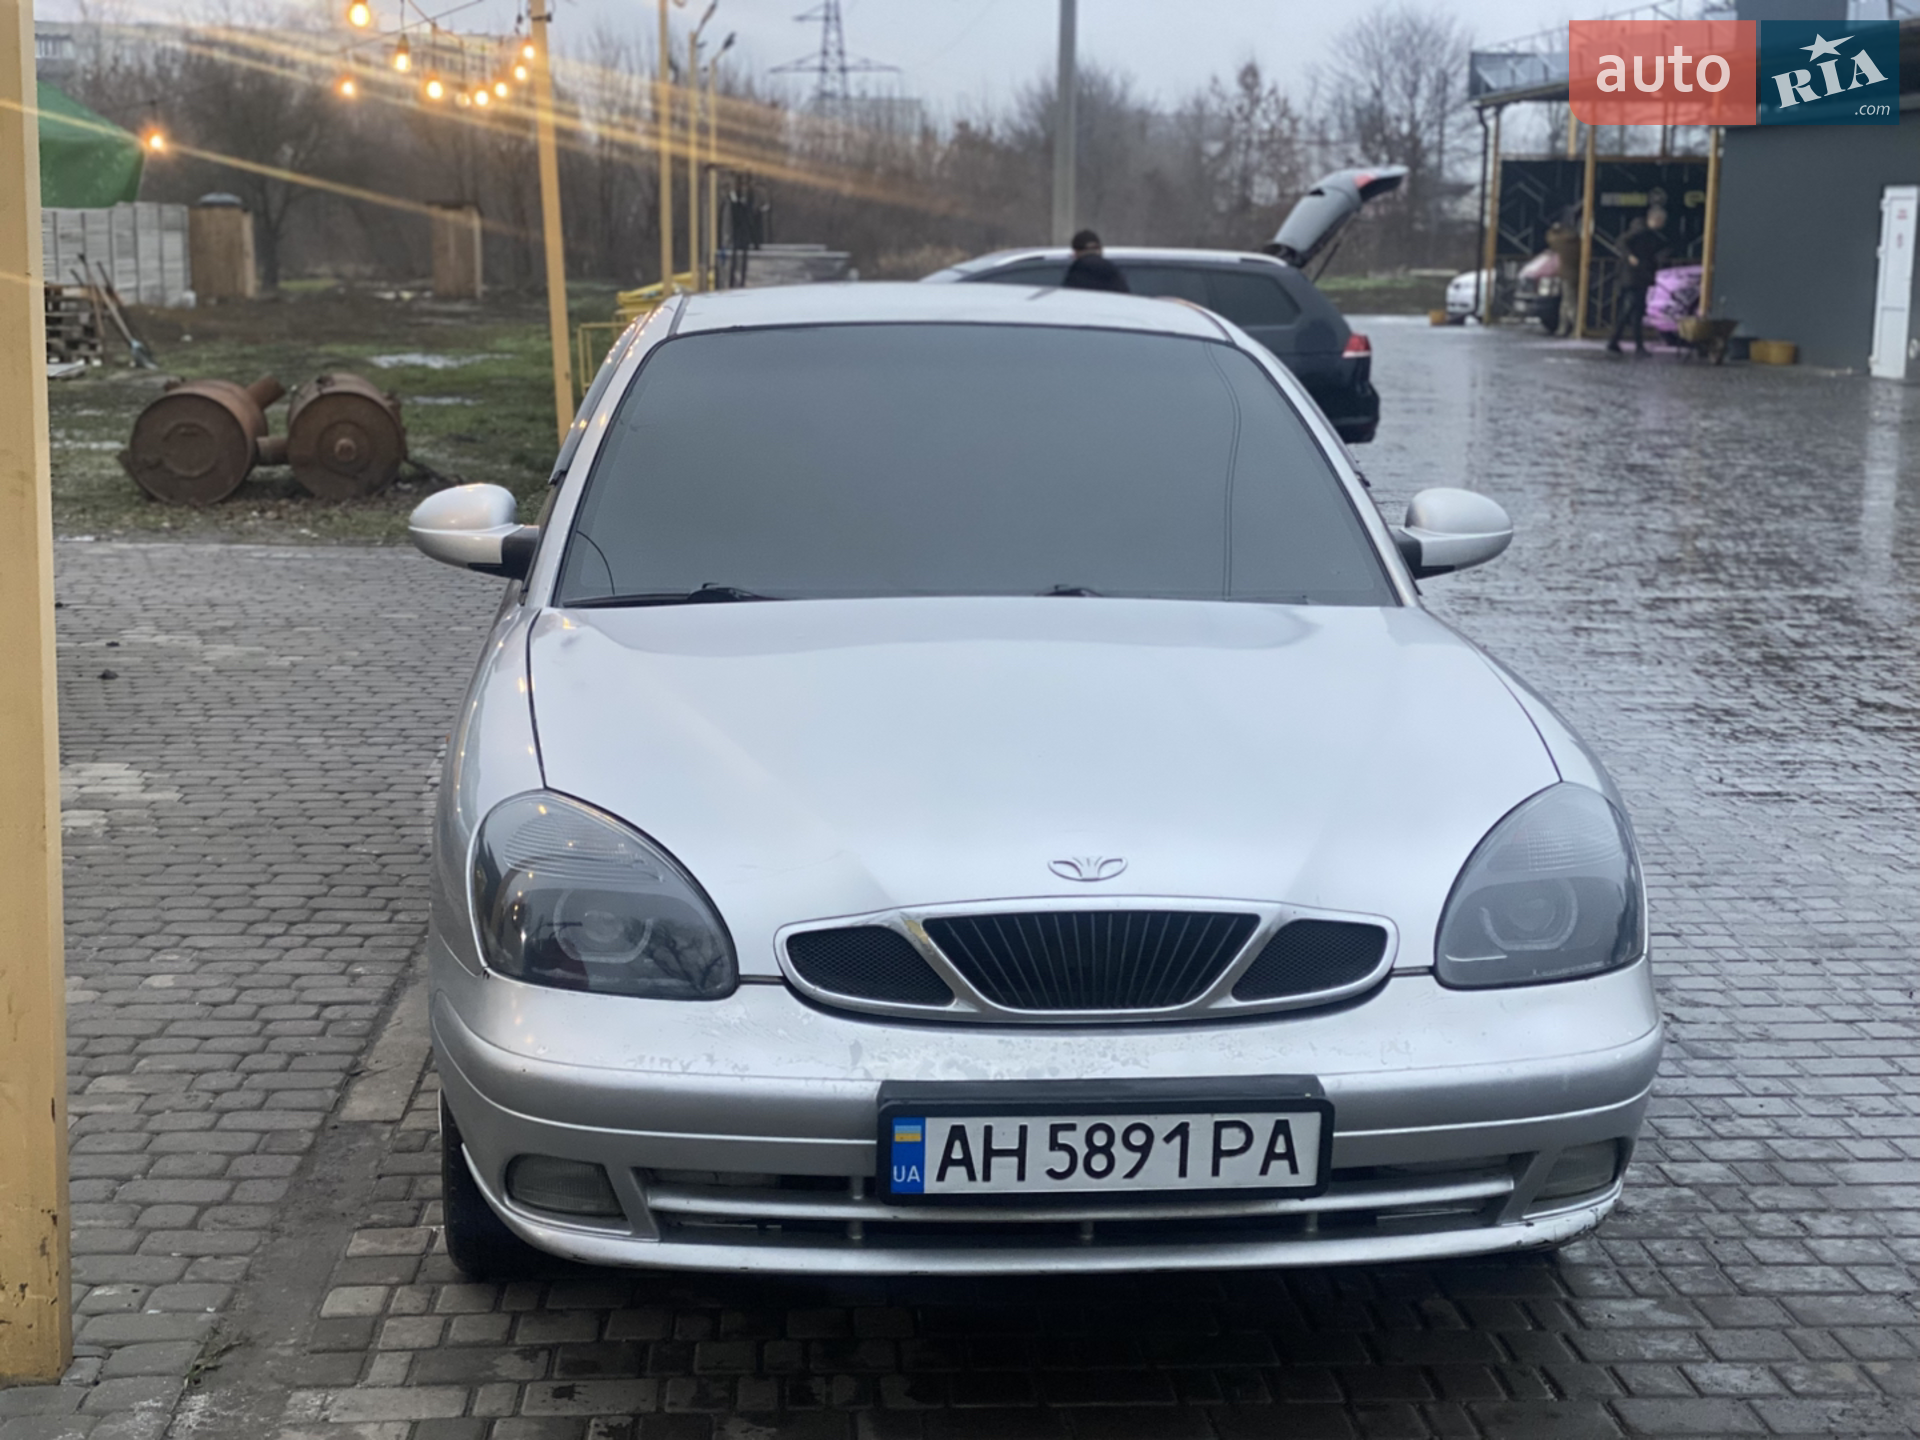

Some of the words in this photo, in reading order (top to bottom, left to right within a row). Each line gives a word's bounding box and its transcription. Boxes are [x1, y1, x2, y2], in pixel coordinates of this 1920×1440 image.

[935, 1124, 1028, 1183] AH
[1045, 1121, 1190, 1181] 5891
[1211, 1118, 1300, 1178] PA
[893, 1165, 921, 1184] UA
